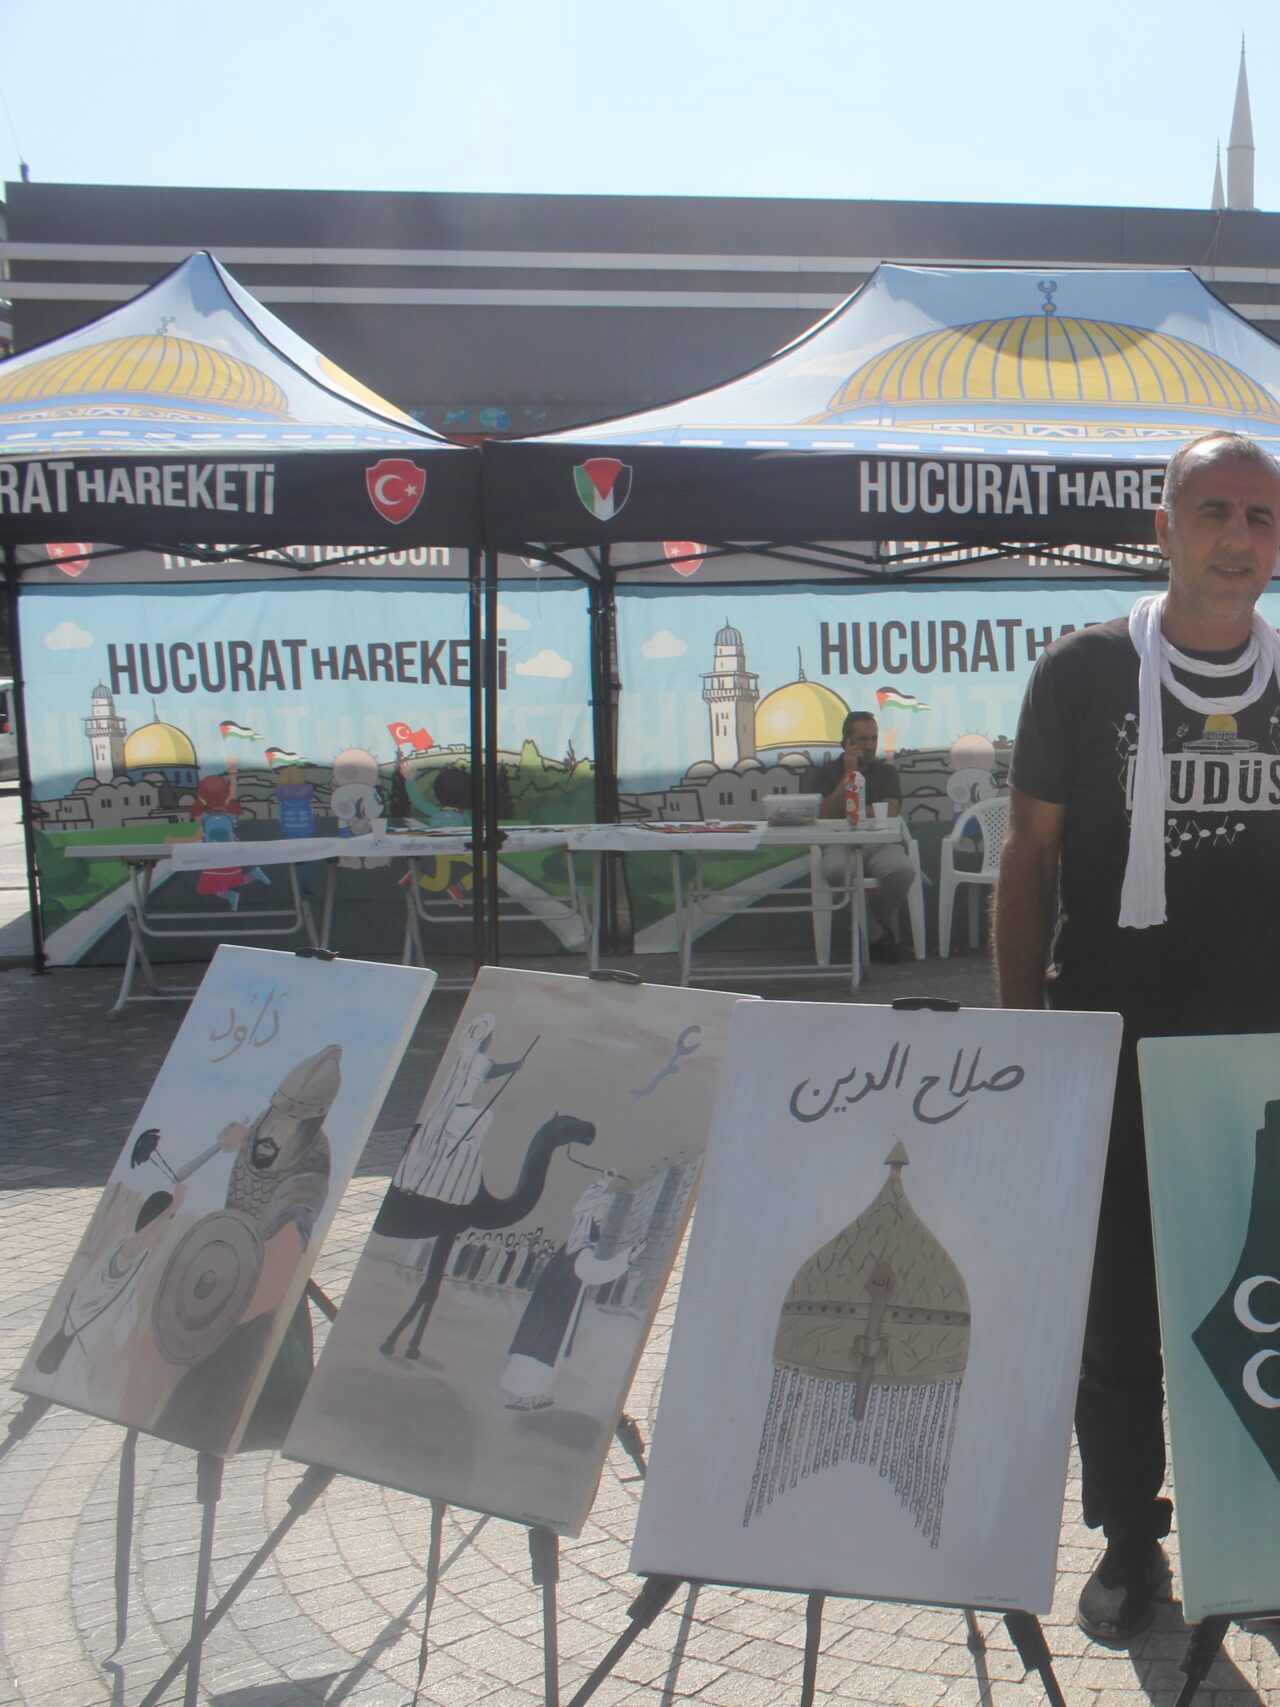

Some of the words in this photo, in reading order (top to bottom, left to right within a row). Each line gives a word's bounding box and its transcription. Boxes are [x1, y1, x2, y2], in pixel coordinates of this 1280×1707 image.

[76, 463, 275, 515] HAREKETİ
[860, 461, 1056, 515] HUCURAT
[1059, 468, 1165, 511] HARE
[107, 639, 307, 695] HUCURAT
[311, 638, 507, 690] HAREKEİ
[820, 619, 1022, 675] HUCURAT
[790, 1041, 911, 1123] الدين
[913, 1047, 1025, 1124] صلاح
